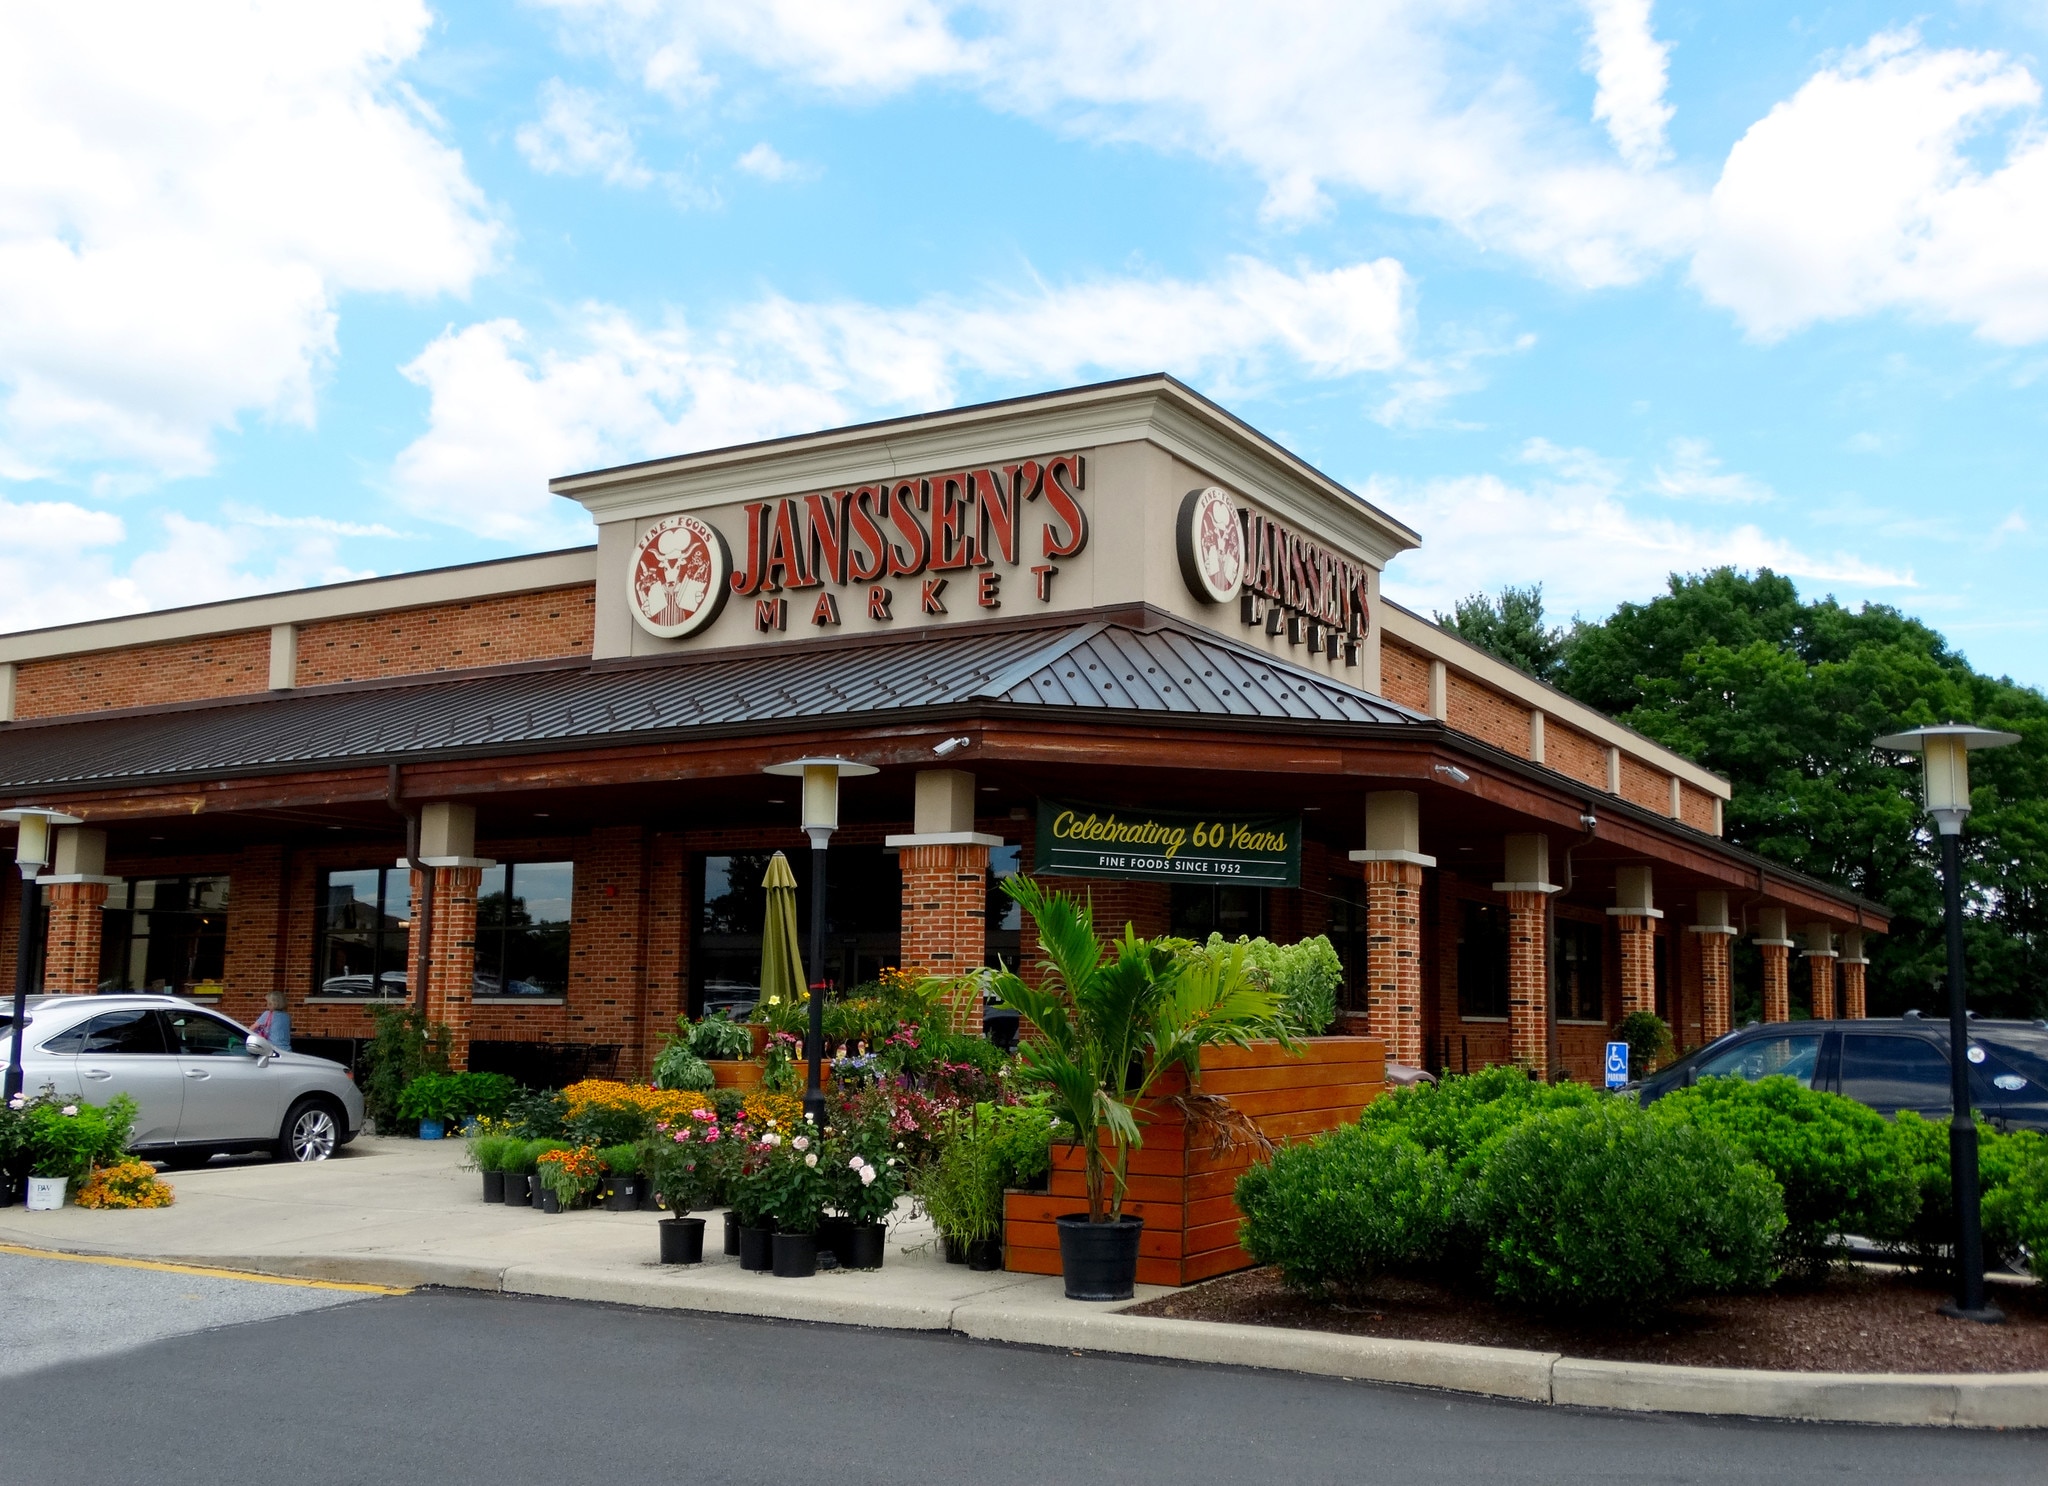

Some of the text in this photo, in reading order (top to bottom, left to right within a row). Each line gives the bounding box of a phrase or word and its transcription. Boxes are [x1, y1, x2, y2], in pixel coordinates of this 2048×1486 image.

[1201, 490, 1216, 508] FINE
[638, 517, 712, 550] FINE FOODS
[730, 454, 1087, 596] JANSSEN'S
[755, 565, 1058, 632] MARKET
[1053, 811, 1288, 859] Celebrating 60 Years
[1099, 856, 1241, 874] FINE FOODS SINCE 1952
